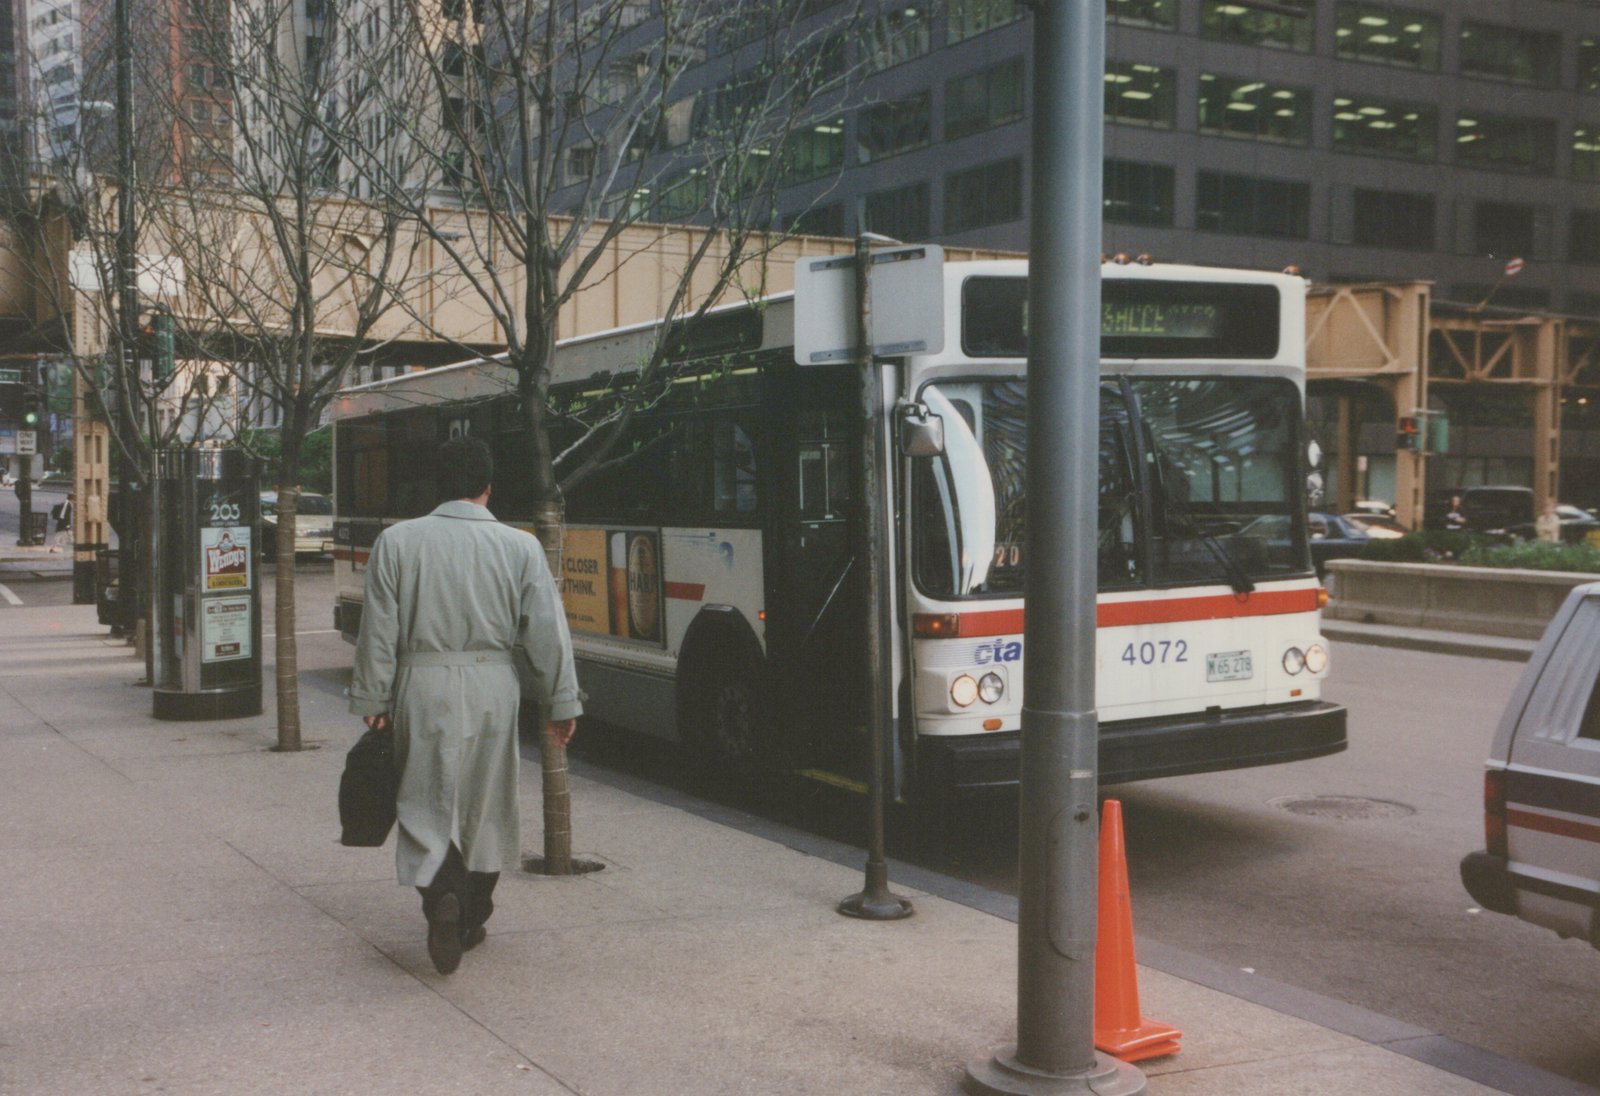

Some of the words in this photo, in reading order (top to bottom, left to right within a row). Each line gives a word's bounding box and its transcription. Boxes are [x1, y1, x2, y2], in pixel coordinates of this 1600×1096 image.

[210, 503, 240, 520] 203
[567, 558, 598, 575] CLOSER
[1121, 639, 1188, 666] 4072
